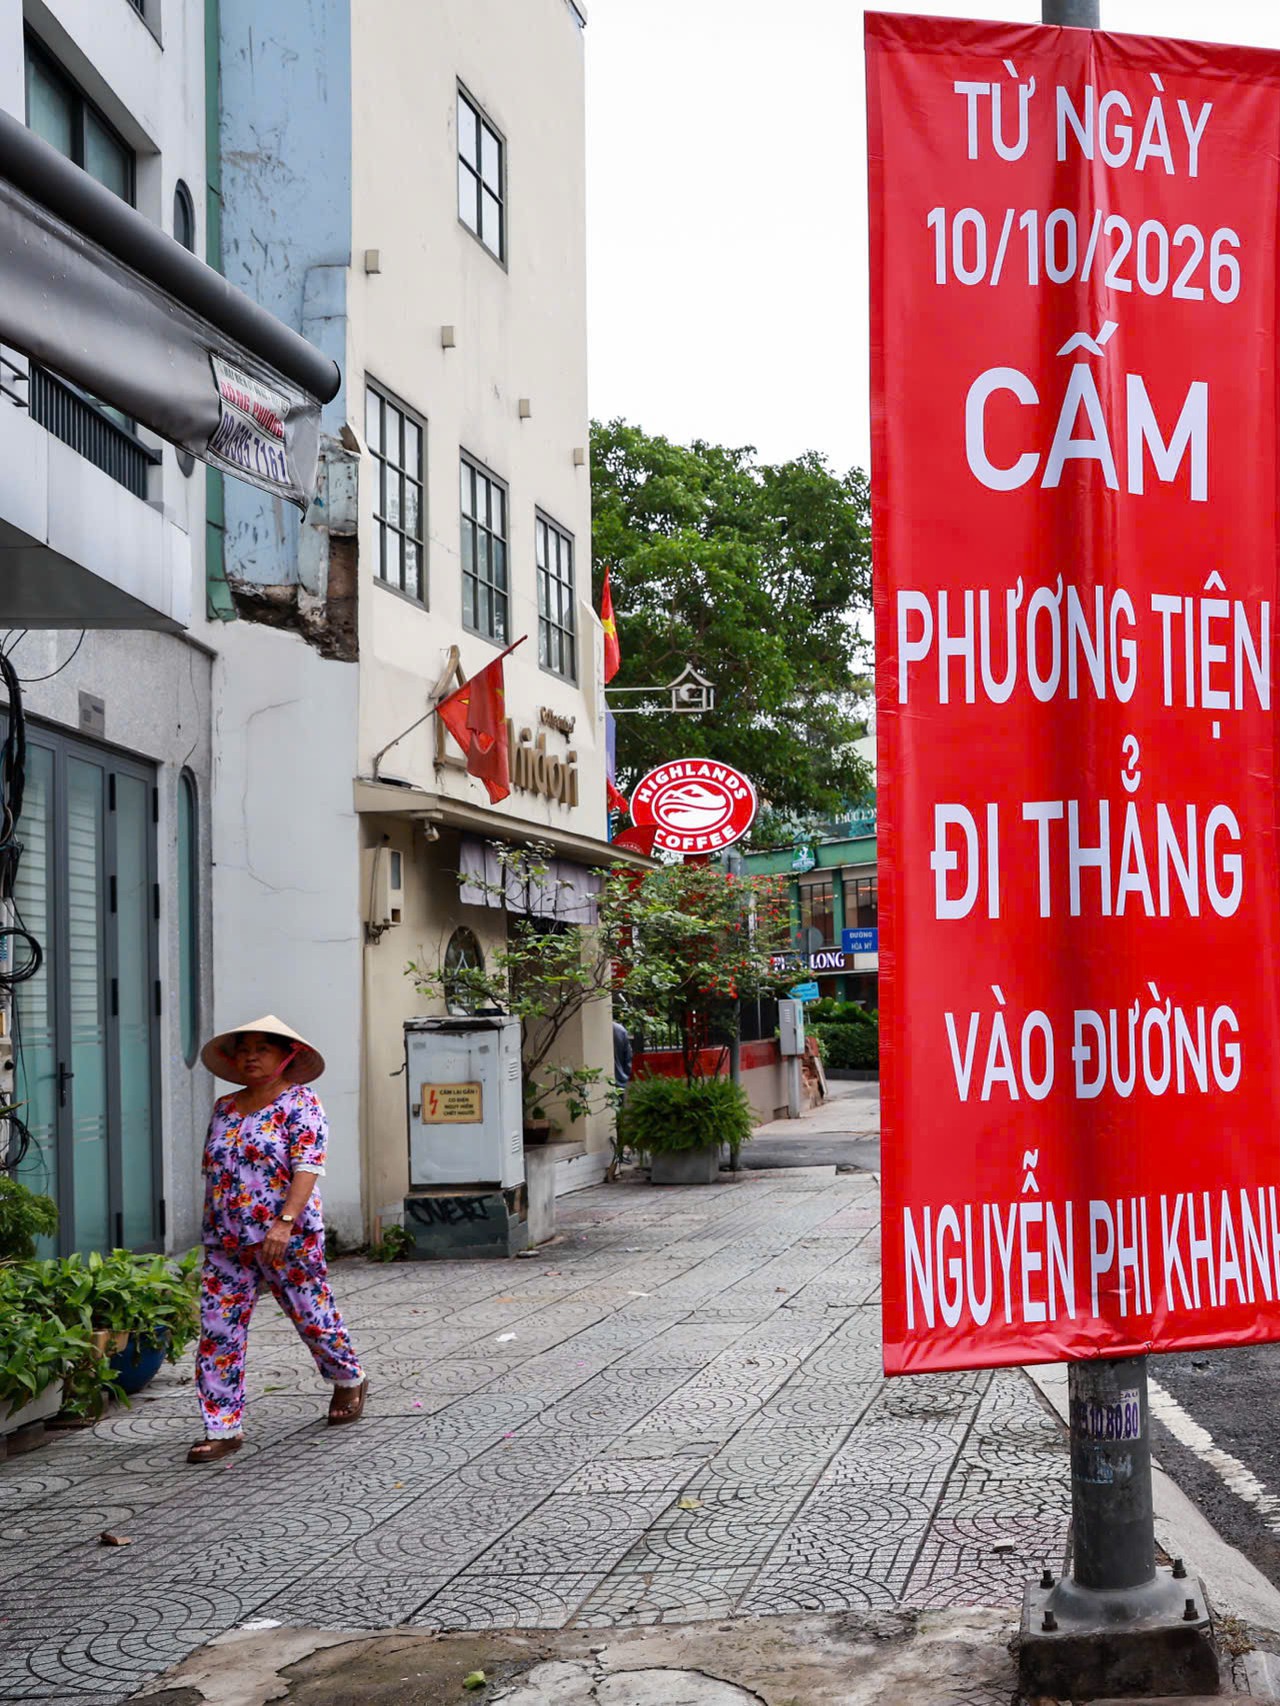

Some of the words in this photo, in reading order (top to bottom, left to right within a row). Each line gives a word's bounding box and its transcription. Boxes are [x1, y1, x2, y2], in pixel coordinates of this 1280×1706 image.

[954, 60, 1035, 162] TỪ
[1056, 73, 1212, 178] NGÀY
[927, 208, 1240, 304] 10/10/2026
[965, 320, 1209, 502] CẤM
[897, 573, 1138, 704] PHƯƠNG
[1151, 571, 1270, 739] TIỆN
[506, 716, 579, 807] hidori
[638, 763, 748, 804] HIGHLANDS
[654, 824, 737, 850] COFFEE
[930, 803, 1000, 920] ĐI
[1022, 734, 1243, 919] THẲNG
[810, 952, 845, 970] LONG
[945, 985, 1055, 1102] VÀO
[1072, 982, 1241, 1099] ĐƯỜNG
[903, 1148, 1076, 1330] NGUYỄN
[1089, 1196, 1152, 1319] PHI
